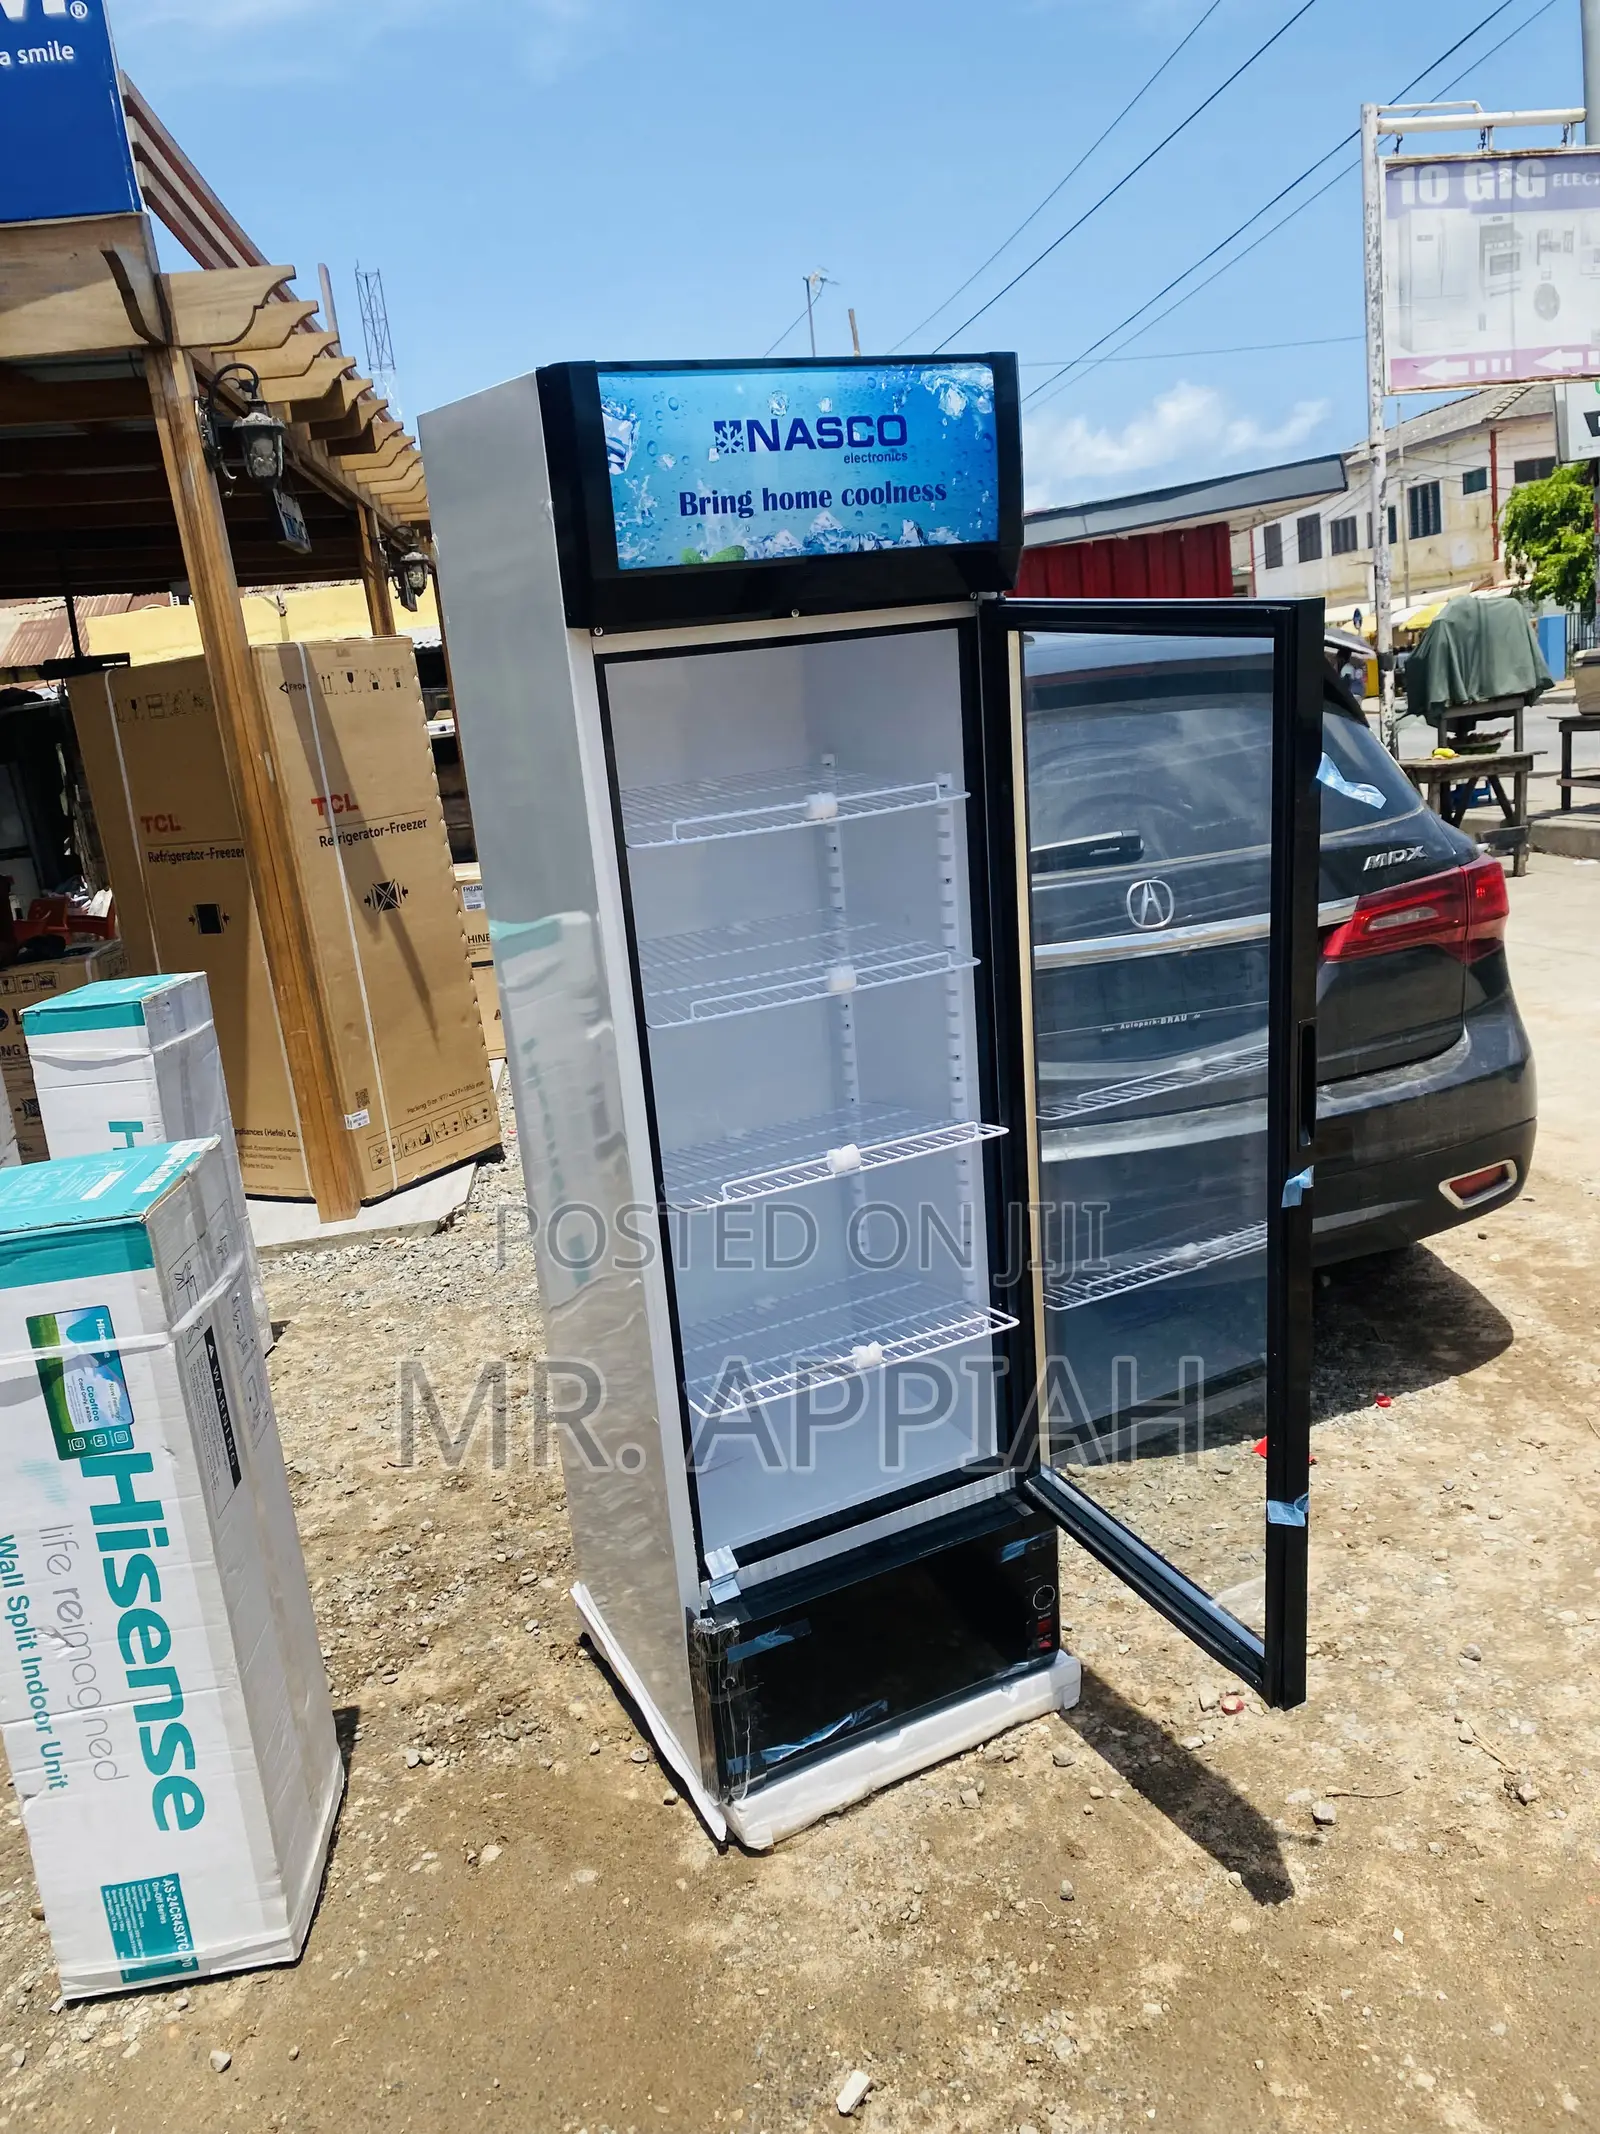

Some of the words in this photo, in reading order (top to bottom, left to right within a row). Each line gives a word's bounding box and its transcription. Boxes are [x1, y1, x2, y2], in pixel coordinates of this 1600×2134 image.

[17, 40, 75, 64] smile
[1393, 165, 1450, 205] 10
[747, 414, 909, 453] NASCO
[843, 451, 908, 465] electronics
[679, 487, 755, 519] Bring
[762, 486, 833, 512] home
[841, 480, 947, 508] coolness
[140, 813, 182, 834] TCL
[310, 793, 360, 816] TCL
[319, 817, 428, 849] Rerigerator-Freezer
[147, 846, 246, 866] Refrigerator-Freezer
[1363, 845, 1429, 871] MDX
[209, 1366, 239, 1467] WARNING
[0, 1534, 25, 1588] Wall
[39, 1524, 79, 1575] life
[5, 1595, 38, 1651] Split
[79, 1452, 205, 1832] Hisense
[21, 1656, 53, 1734] Indoor
[53, 1587, 130, 1782] reimagined
[40, 1741, 69, 1790] Unit
